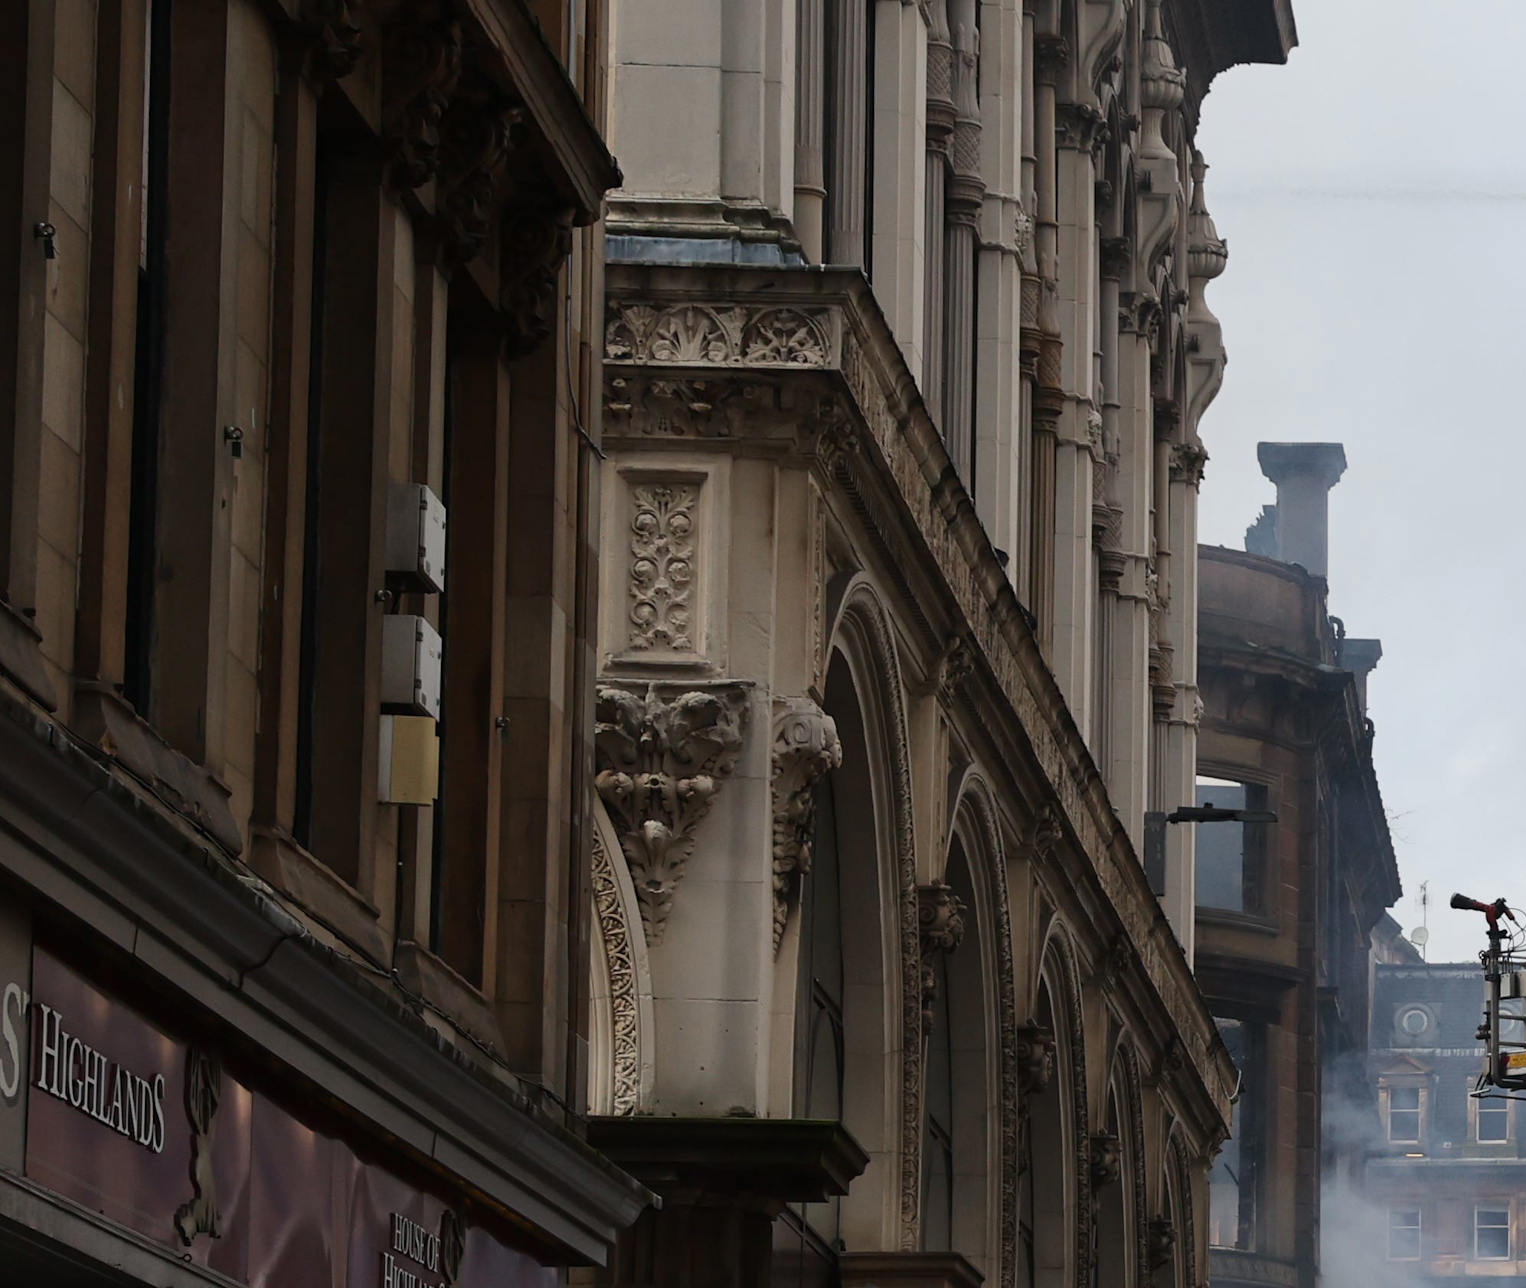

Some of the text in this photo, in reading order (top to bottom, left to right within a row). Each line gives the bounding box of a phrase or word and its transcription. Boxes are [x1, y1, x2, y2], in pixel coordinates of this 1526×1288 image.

[37, 1003, 166, 1154] HIGHLANDS
[393, 1213, 441, 1273] HOUSE OF
